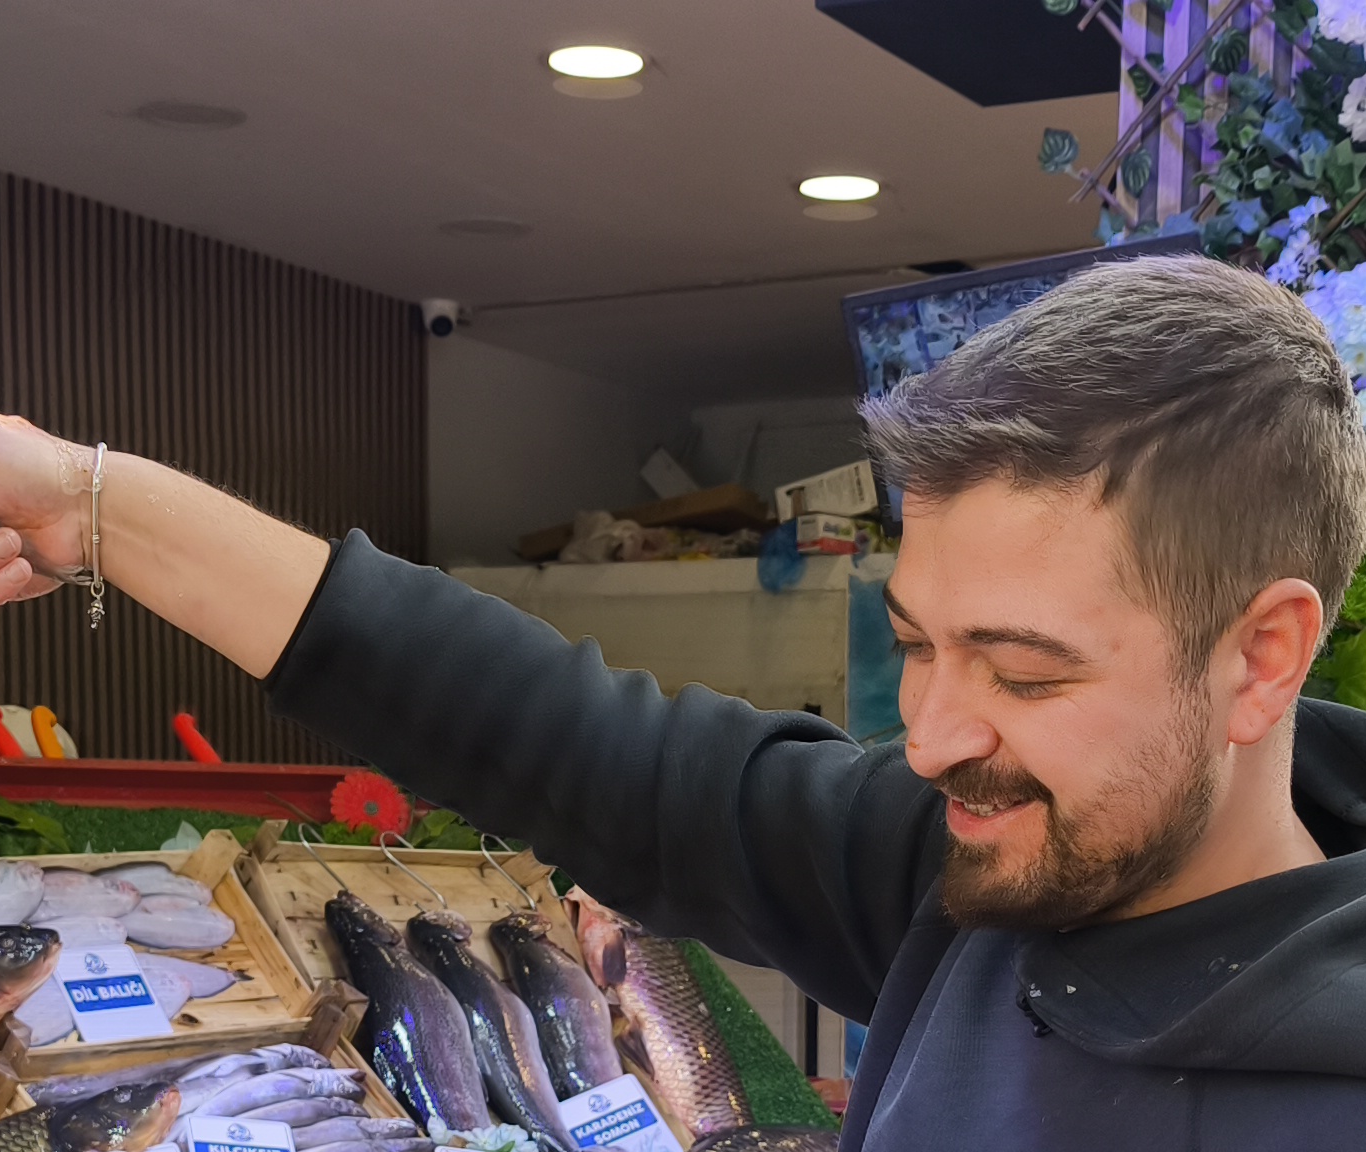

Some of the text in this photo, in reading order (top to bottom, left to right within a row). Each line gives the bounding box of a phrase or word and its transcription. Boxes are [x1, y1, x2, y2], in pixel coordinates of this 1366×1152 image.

[70, 984, 99, 1003] DİL
[575, 1102, 645, 1141] KARADENİZ
[593, 1118, 641, 1146] SOMON
